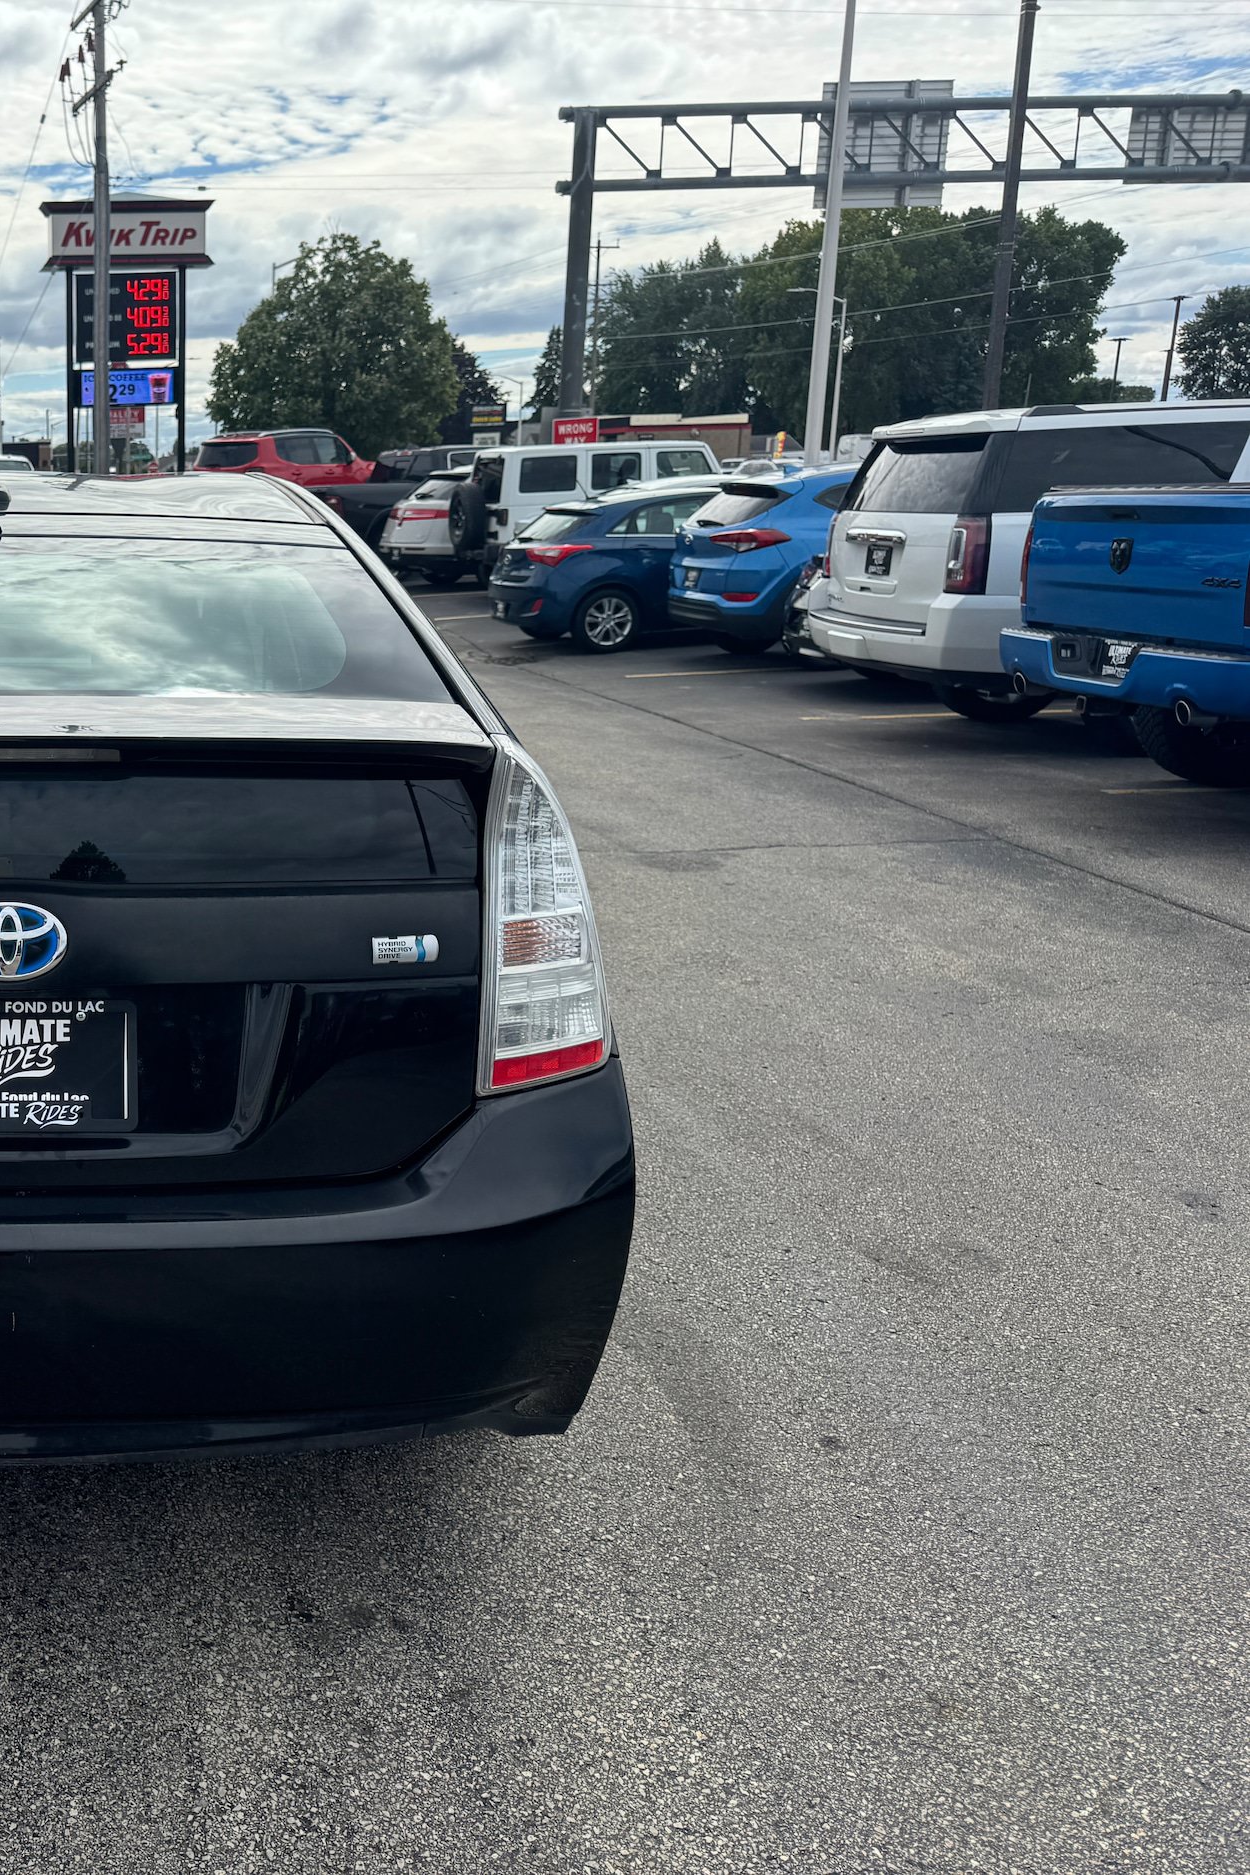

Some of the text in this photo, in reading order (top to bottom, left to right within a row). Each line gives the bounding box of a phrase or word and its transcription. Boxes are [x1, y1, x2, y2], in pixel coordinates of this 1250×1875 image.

[139, 220, 197, 246] TRIP
[109, 372, 147, 383] COFFEE
[557, 422, 594, 436] WRONG
[4, 1001, 48, 1013] FOND
[52, 1001, 73, 1013] DU
[77, 1001, 105, 1013] LAC
